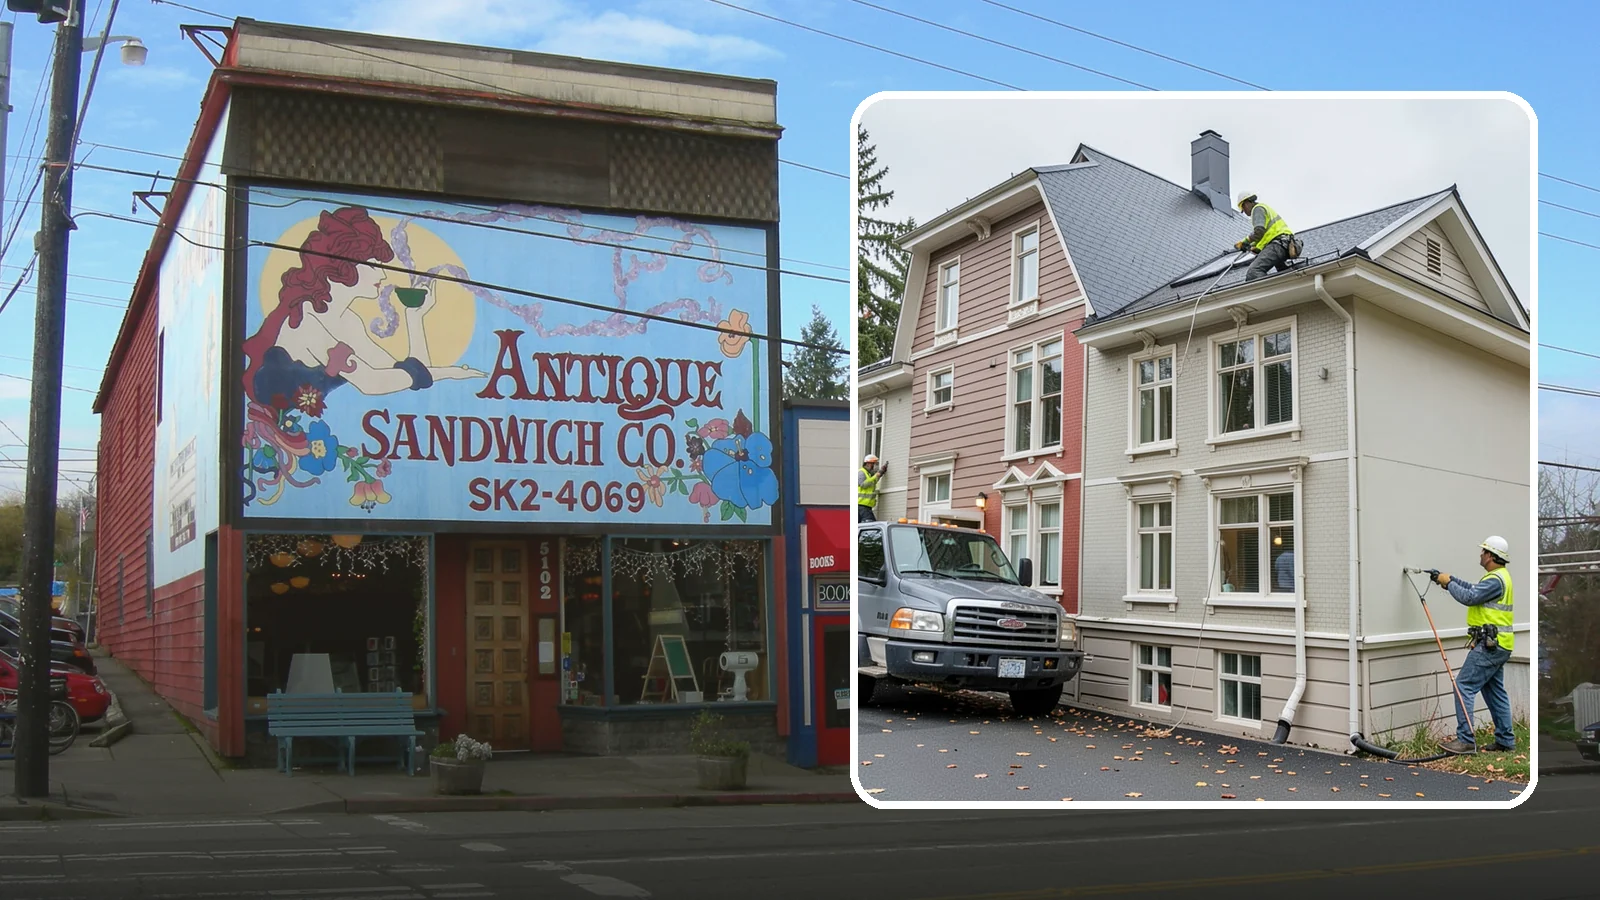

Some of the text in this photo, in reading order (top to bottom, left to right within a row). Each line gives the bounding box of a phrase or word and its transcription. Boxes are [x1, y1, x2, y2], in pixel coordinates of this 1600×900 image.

[475, 328, 724, 421] ANTIQUE
[361, 408, 685, 468] SANDWICH CO.
[468, 476, 645, 513] SK2-4069
[539, 541, 551, 600] 5102
[809, 555, 835, 569] BOOKS
